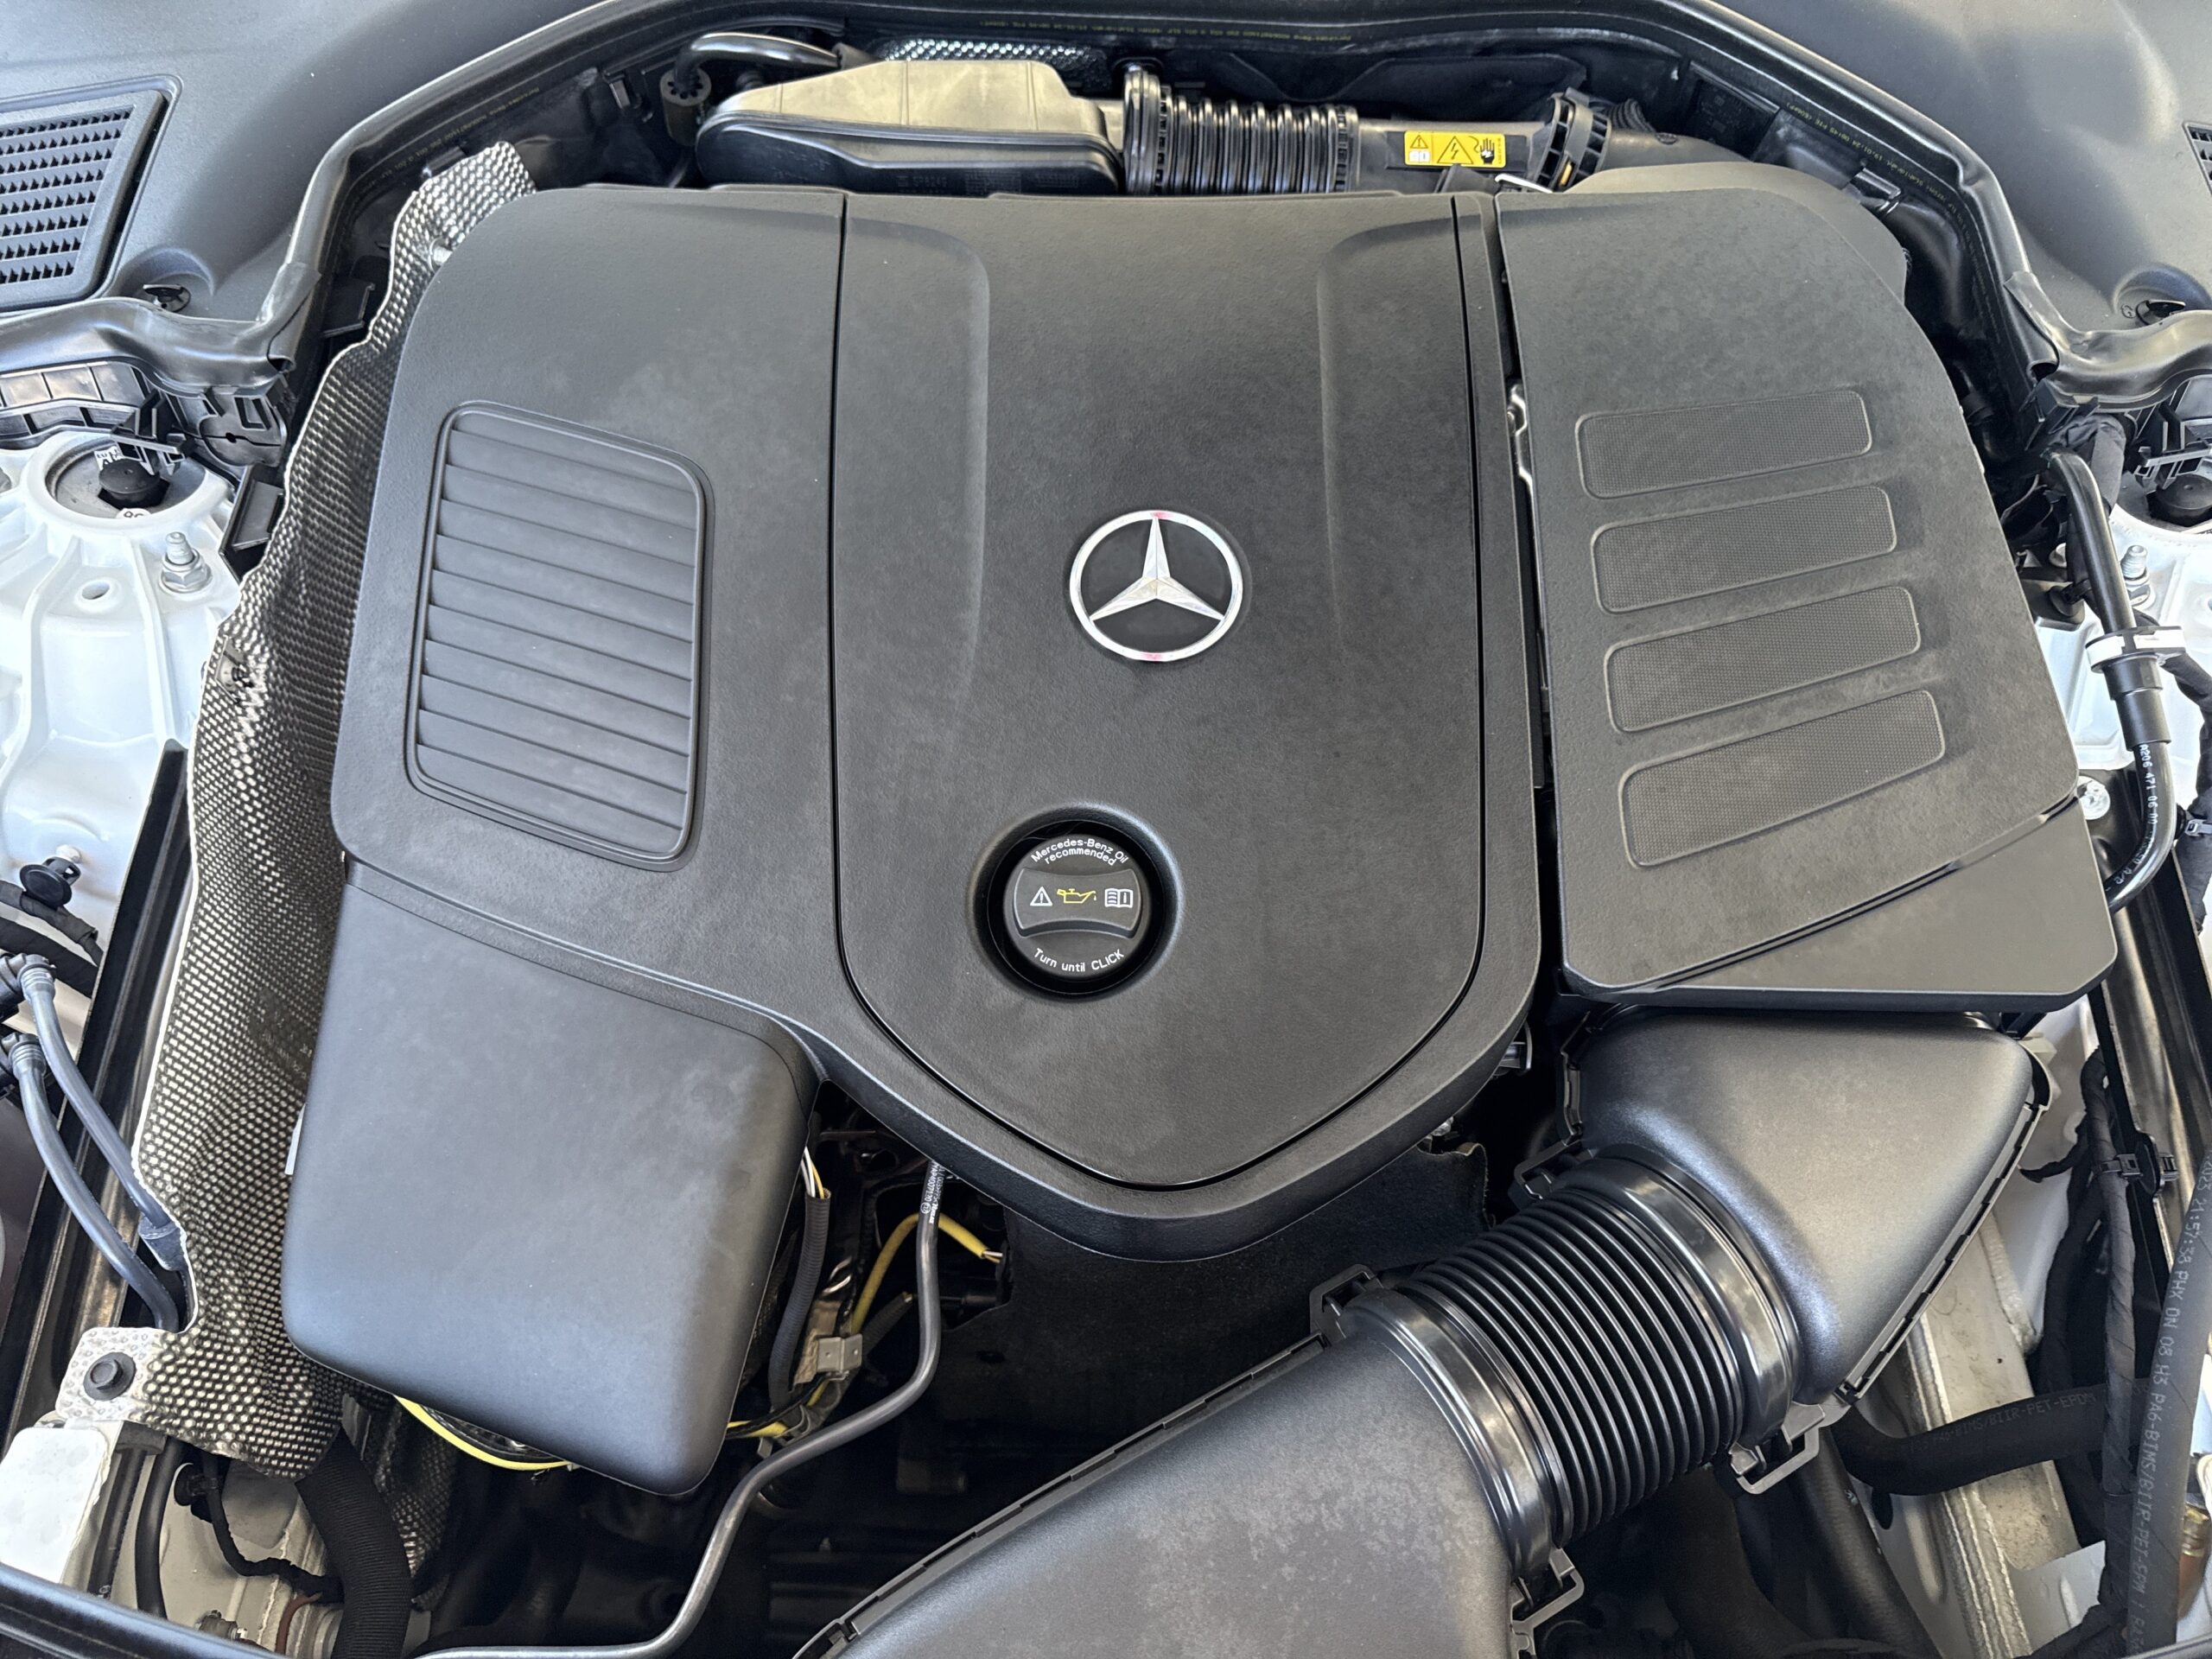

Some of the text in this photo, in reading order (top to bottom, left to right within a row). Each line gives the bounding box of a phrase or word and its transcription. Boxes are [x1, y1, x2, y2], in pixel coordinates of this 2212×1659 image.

[2139, 744, 2152, 768] A206
[2145, 772, 2156, 790] 471
[2147, 796, 2158, 808] 06
[1031, 838, 1128, 864] Mercedes-Benz Oil
[1045, 847, 1117, 866] recommended
[1034, 948, 1125, 972] Turn until CLICK
[2177, 1198, 2207, 1263] 21:57:38
[2170, 1270, 2189, 1300] PHX
[2158, 1337, 2174, 1357] 08
